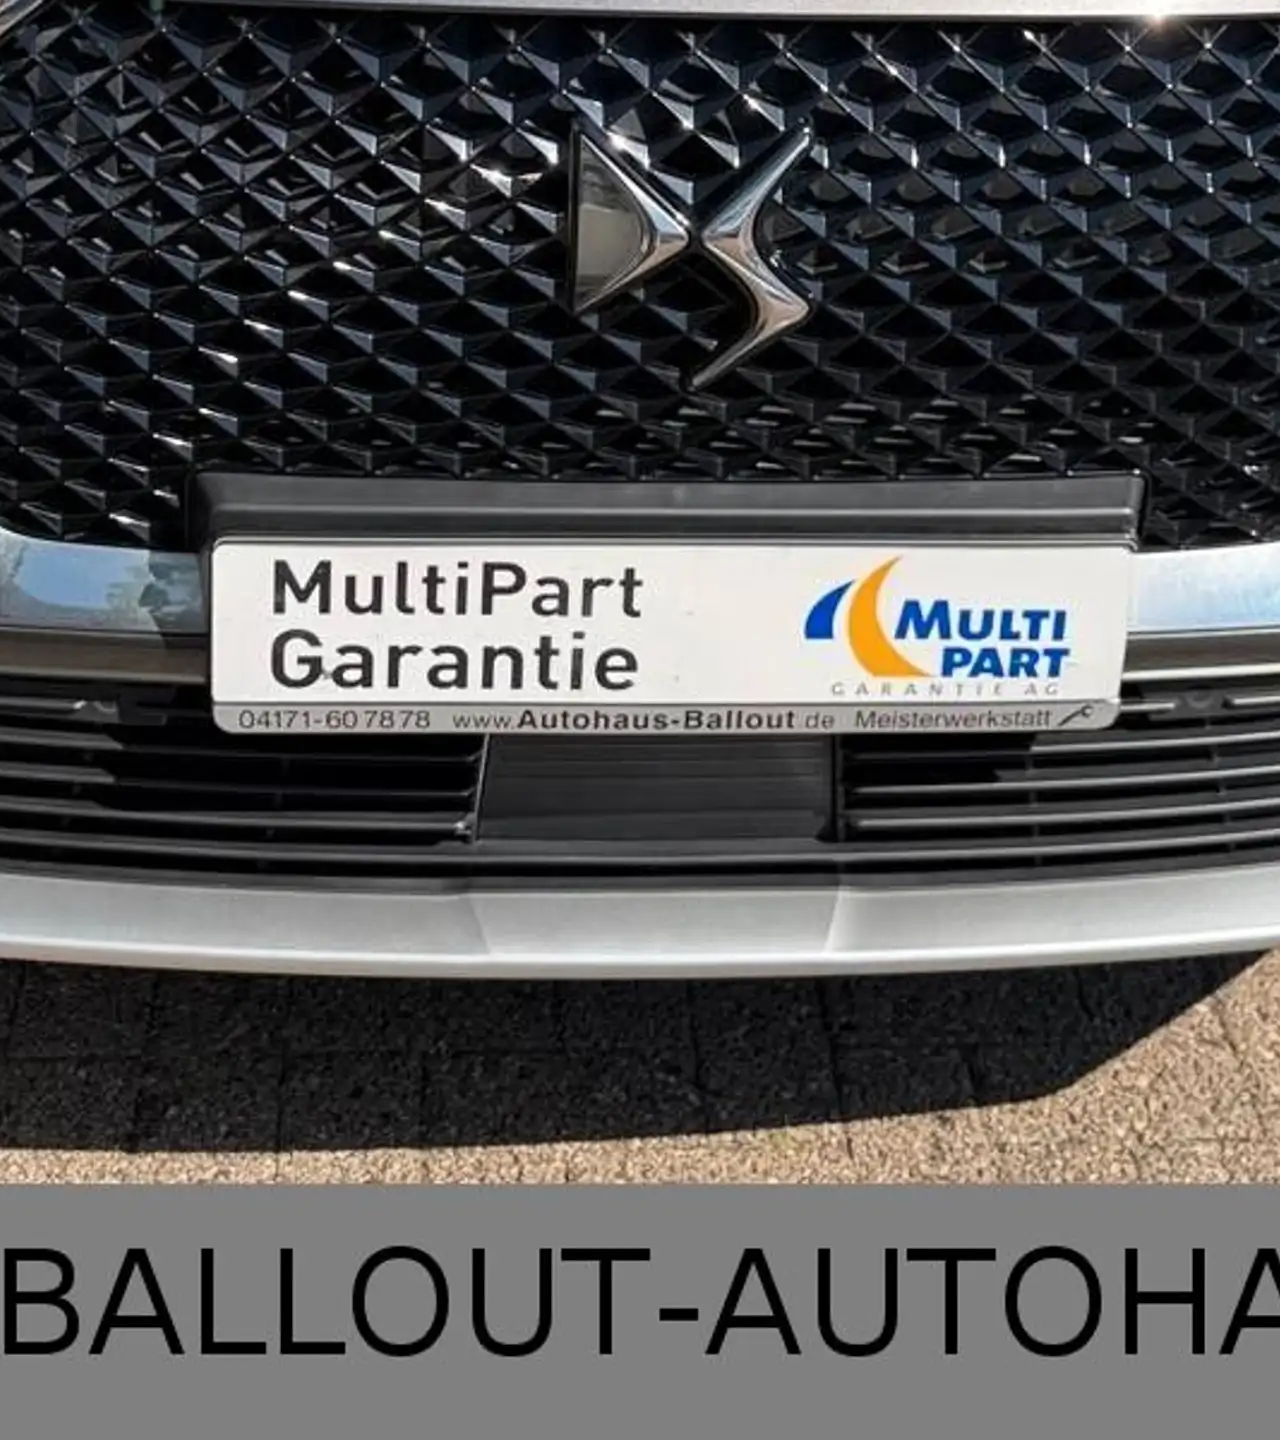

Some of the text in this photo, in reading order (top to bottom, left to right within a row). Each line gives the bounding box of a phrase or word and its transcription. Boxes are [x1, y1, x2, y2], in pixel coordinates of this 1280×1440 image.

[272, 559, 644, 618] MultiPart
[894, 599, 1068, 642] MULTI
[270, 628, 639, 691] Garantie
[940, 646, 1071, 678] PART
[830, 681, 1061, 697] GARANTIE AG
[854, 708, 1054, 729] Meisterwerkstatt
